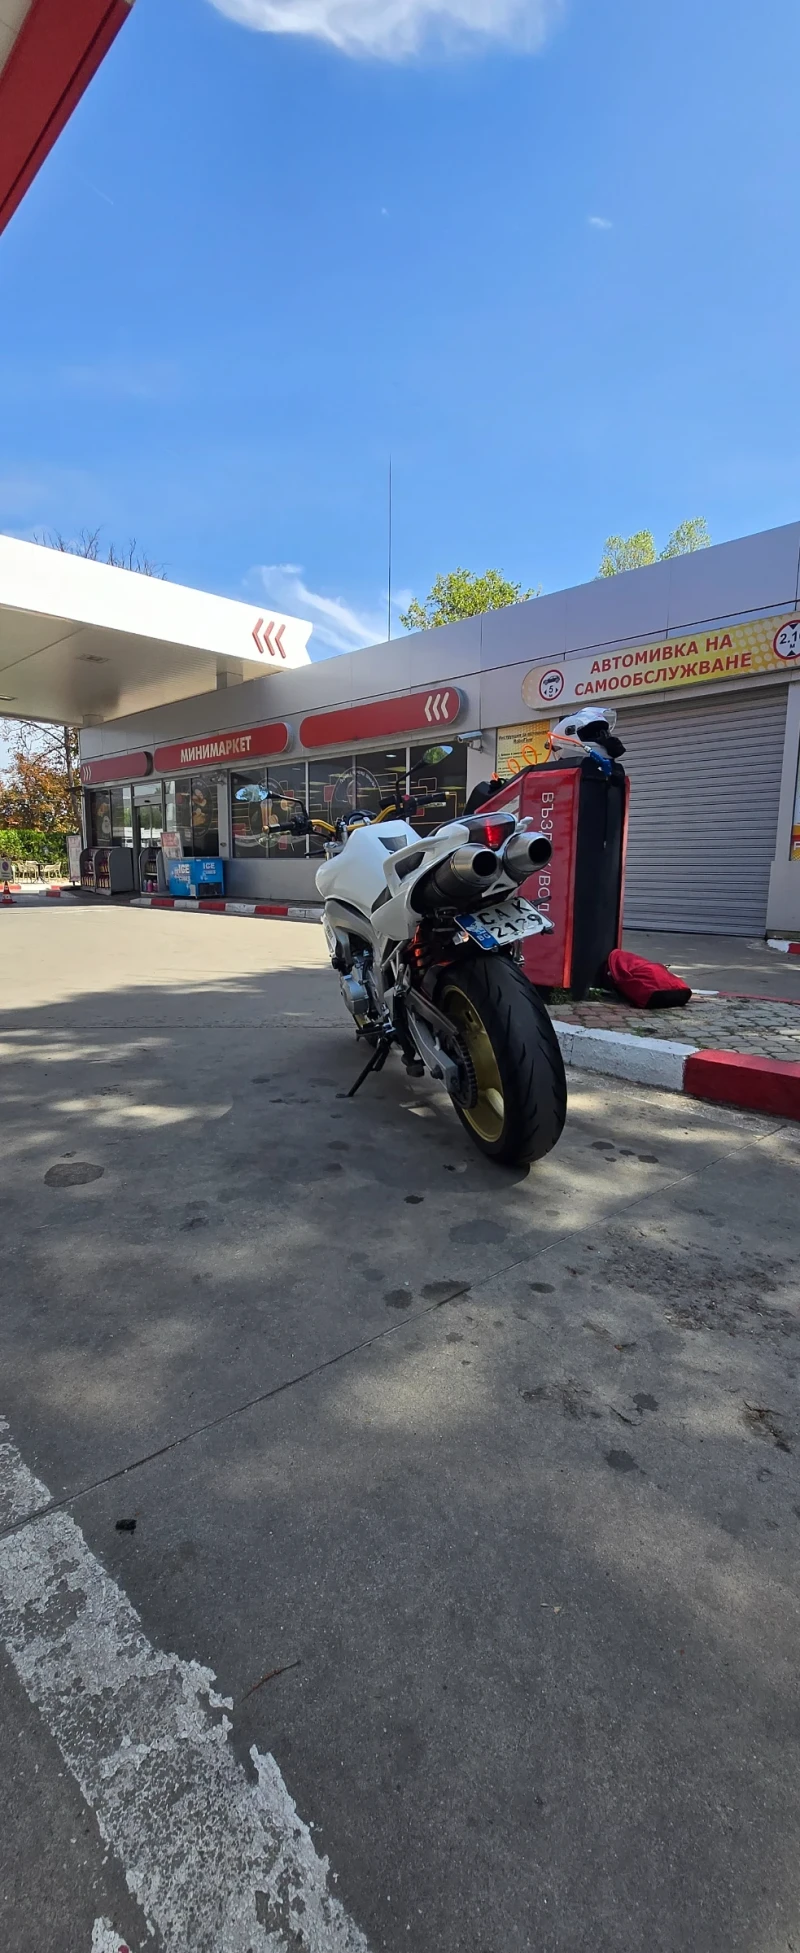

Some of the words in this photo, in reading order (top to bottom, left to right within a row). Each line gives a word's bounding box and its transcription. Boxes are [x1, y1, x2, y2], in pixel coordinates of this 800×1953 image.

[779, 630, 800, 645] 2.1
[590, 640, 699, 675] АВТОМИВКА
[705, 634, 733, 652] НА
[574, 652, 752, 696] САМООБСЛУЖВАНЕ
[180, 735, 252, 763] МИНИМАРКЕТ
[202, 862, 216, 870] ICE
